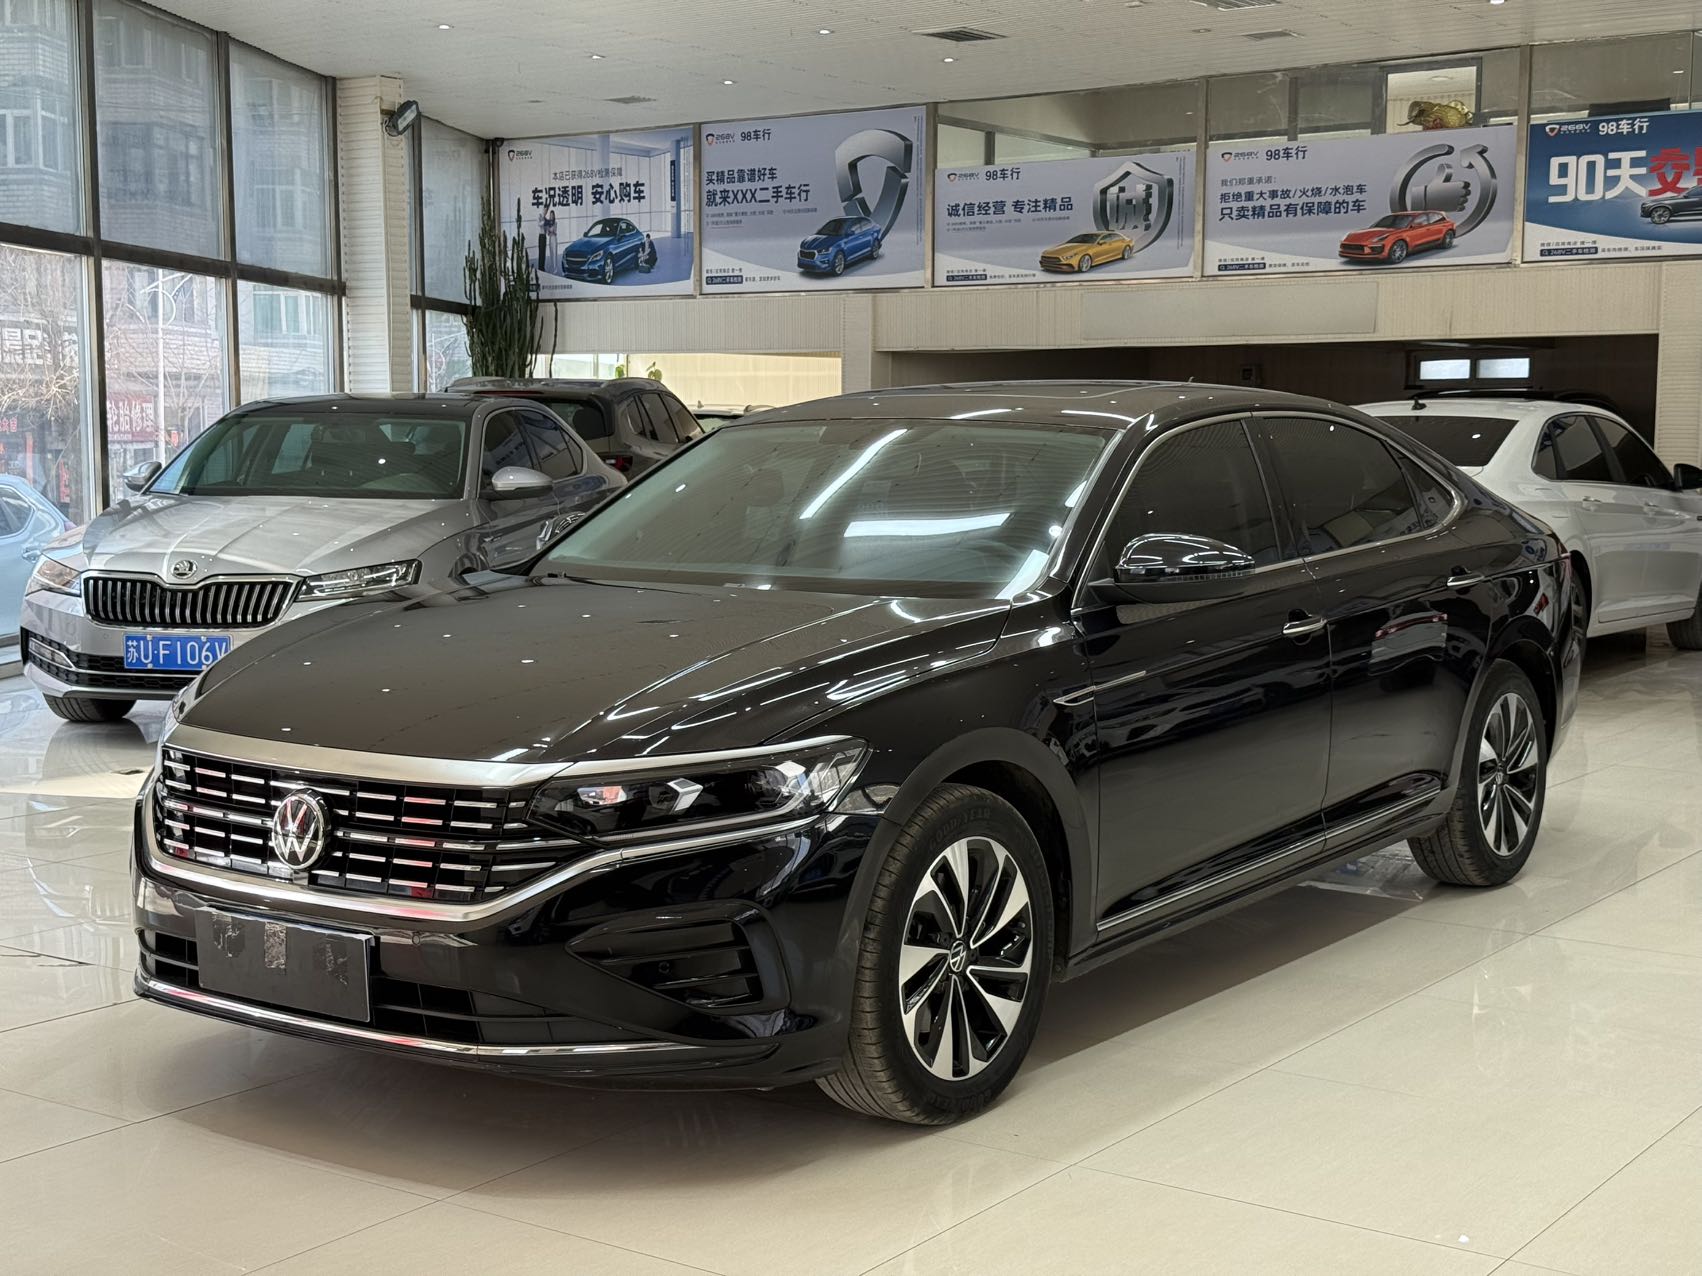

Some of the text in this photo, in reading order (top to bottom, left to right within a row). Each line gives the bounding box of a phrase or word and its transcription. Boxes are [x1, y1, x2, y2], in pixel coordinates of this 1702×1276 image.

[740, 128, 771, 142] 98车行
[1598, 118, 1649, 135] 98车行
[1265, 145, 1308, 161] 98车行
[705, 166, 778, 186] 买精品靠谱好车
[985, 167, 1021, 181] 98车行
[1548, 147, 1702, 203] 90天交
[531, 181, 646, 209] 车况透明 安心购车
[705, 184, 811, 208] 就来XXX二手车行
[1219, 184, 1367, 204] 拒绝重大事故/火烧/水泡车
[946, 196, 1074, 218] 诚信经营 专注精品
[1218, 199, 1367, 222] 只卖精品有保障的车
